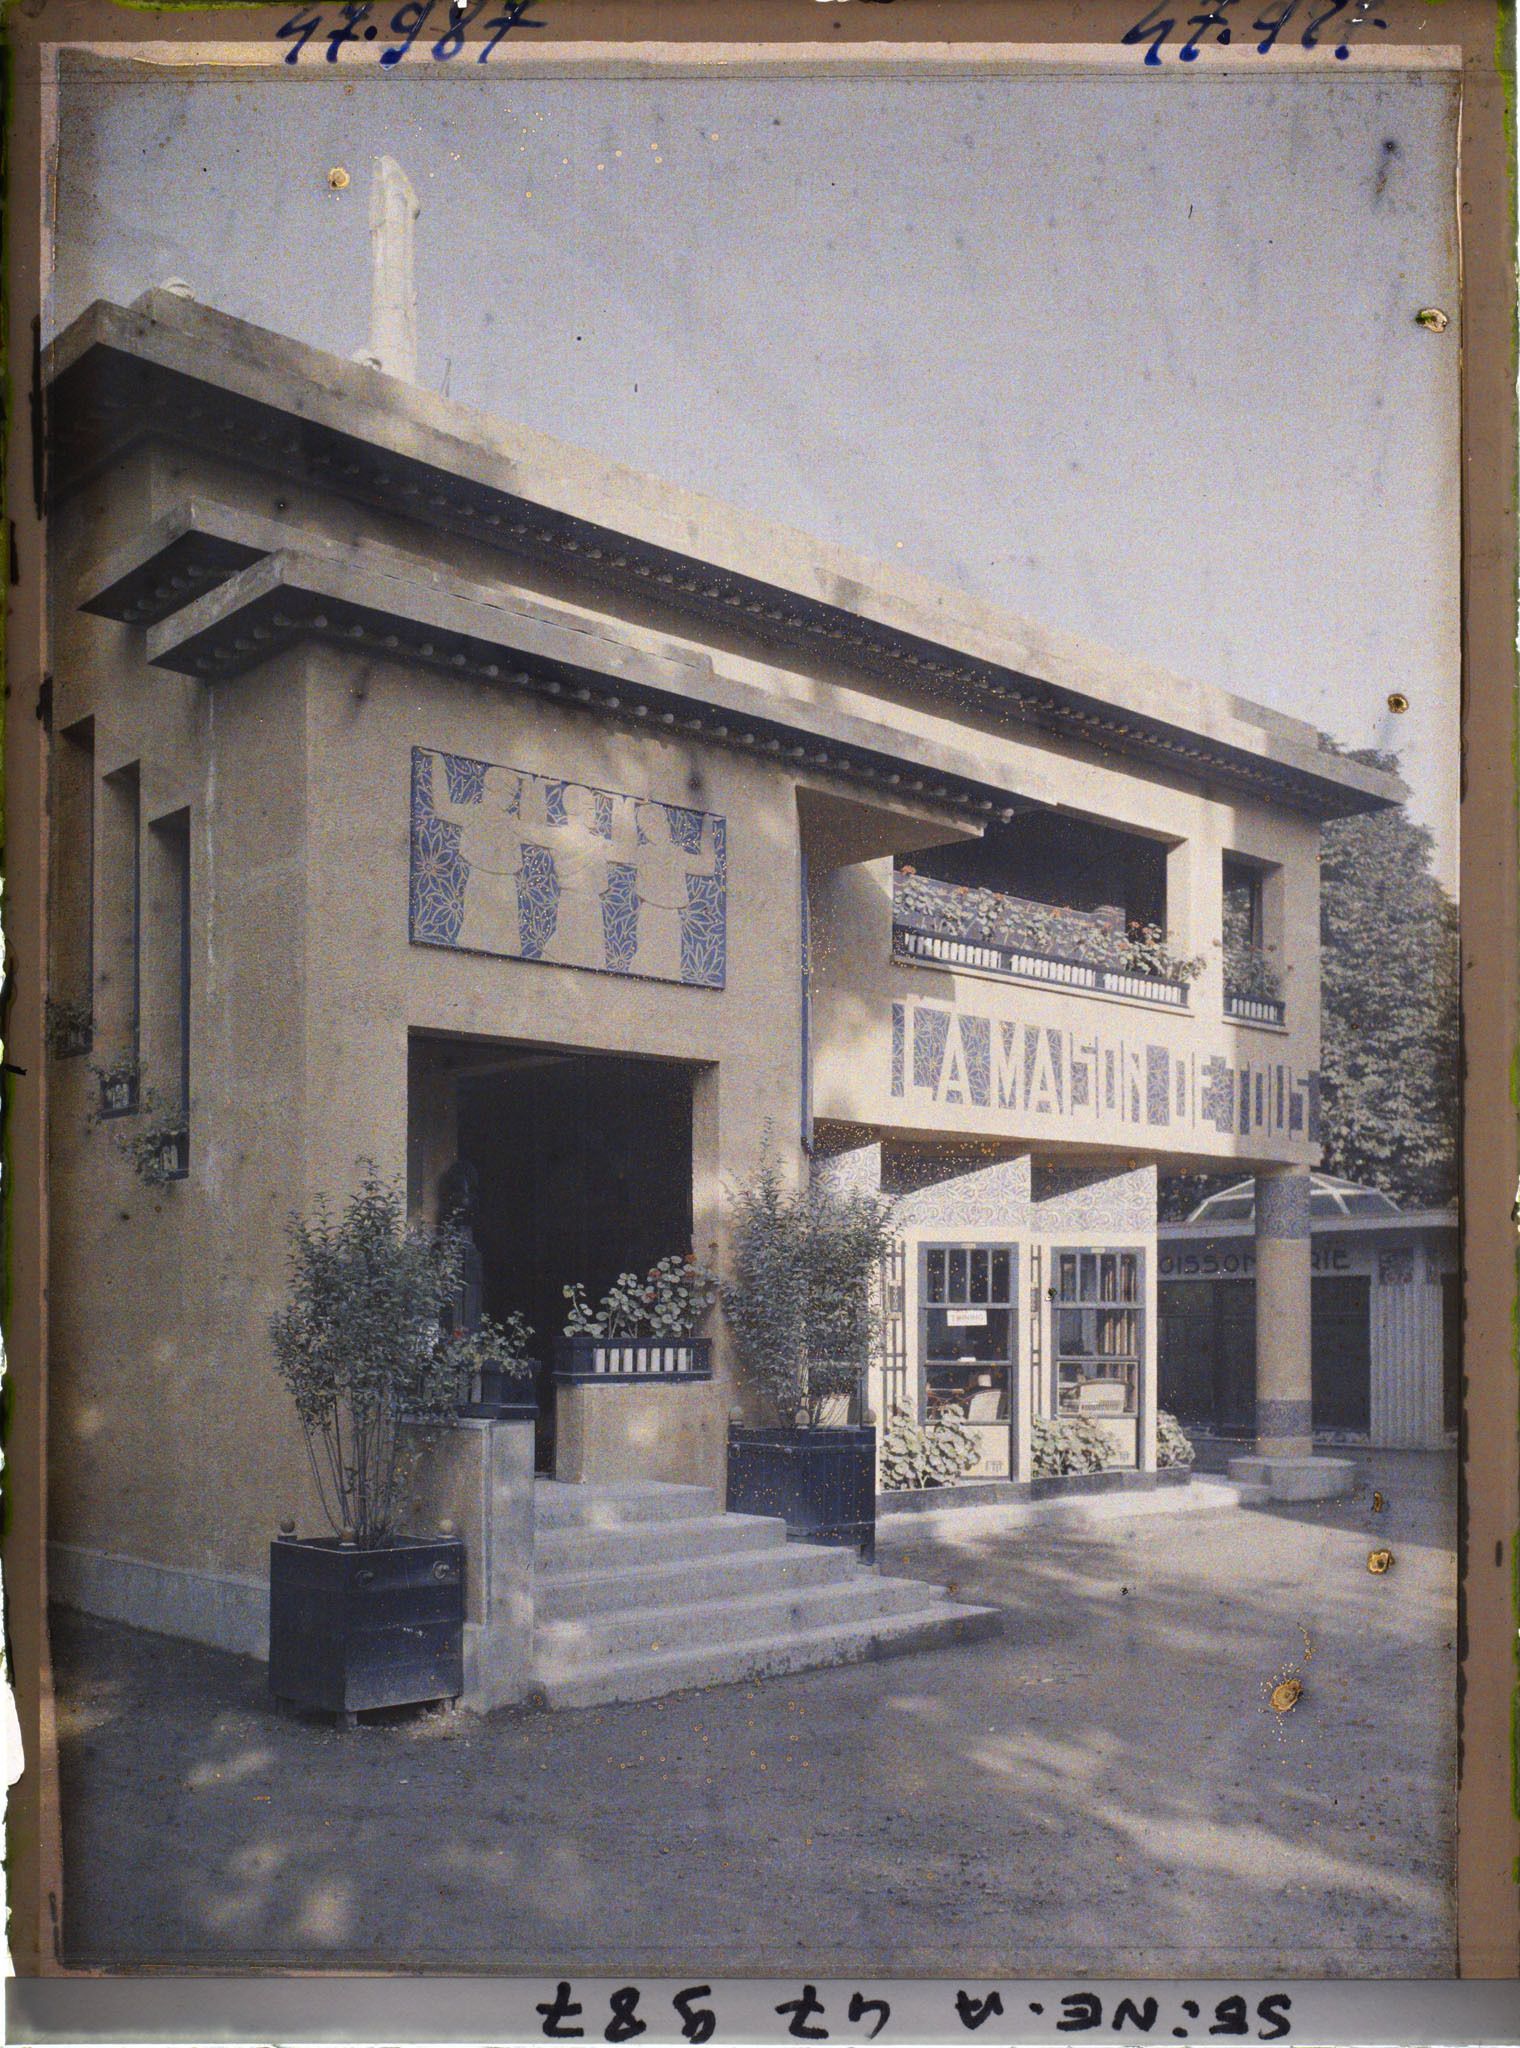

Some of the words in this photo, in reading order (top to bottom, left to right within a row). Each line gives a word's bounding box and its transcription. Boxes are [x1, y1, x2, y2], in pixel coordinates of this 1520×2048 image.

[903, 997, 975, 1106] LA
[991, 1018, 1146, 1125] MAISON
[1168, 1047, 1218, 1132] DE
[536, 1982, 717, 2044] 987
